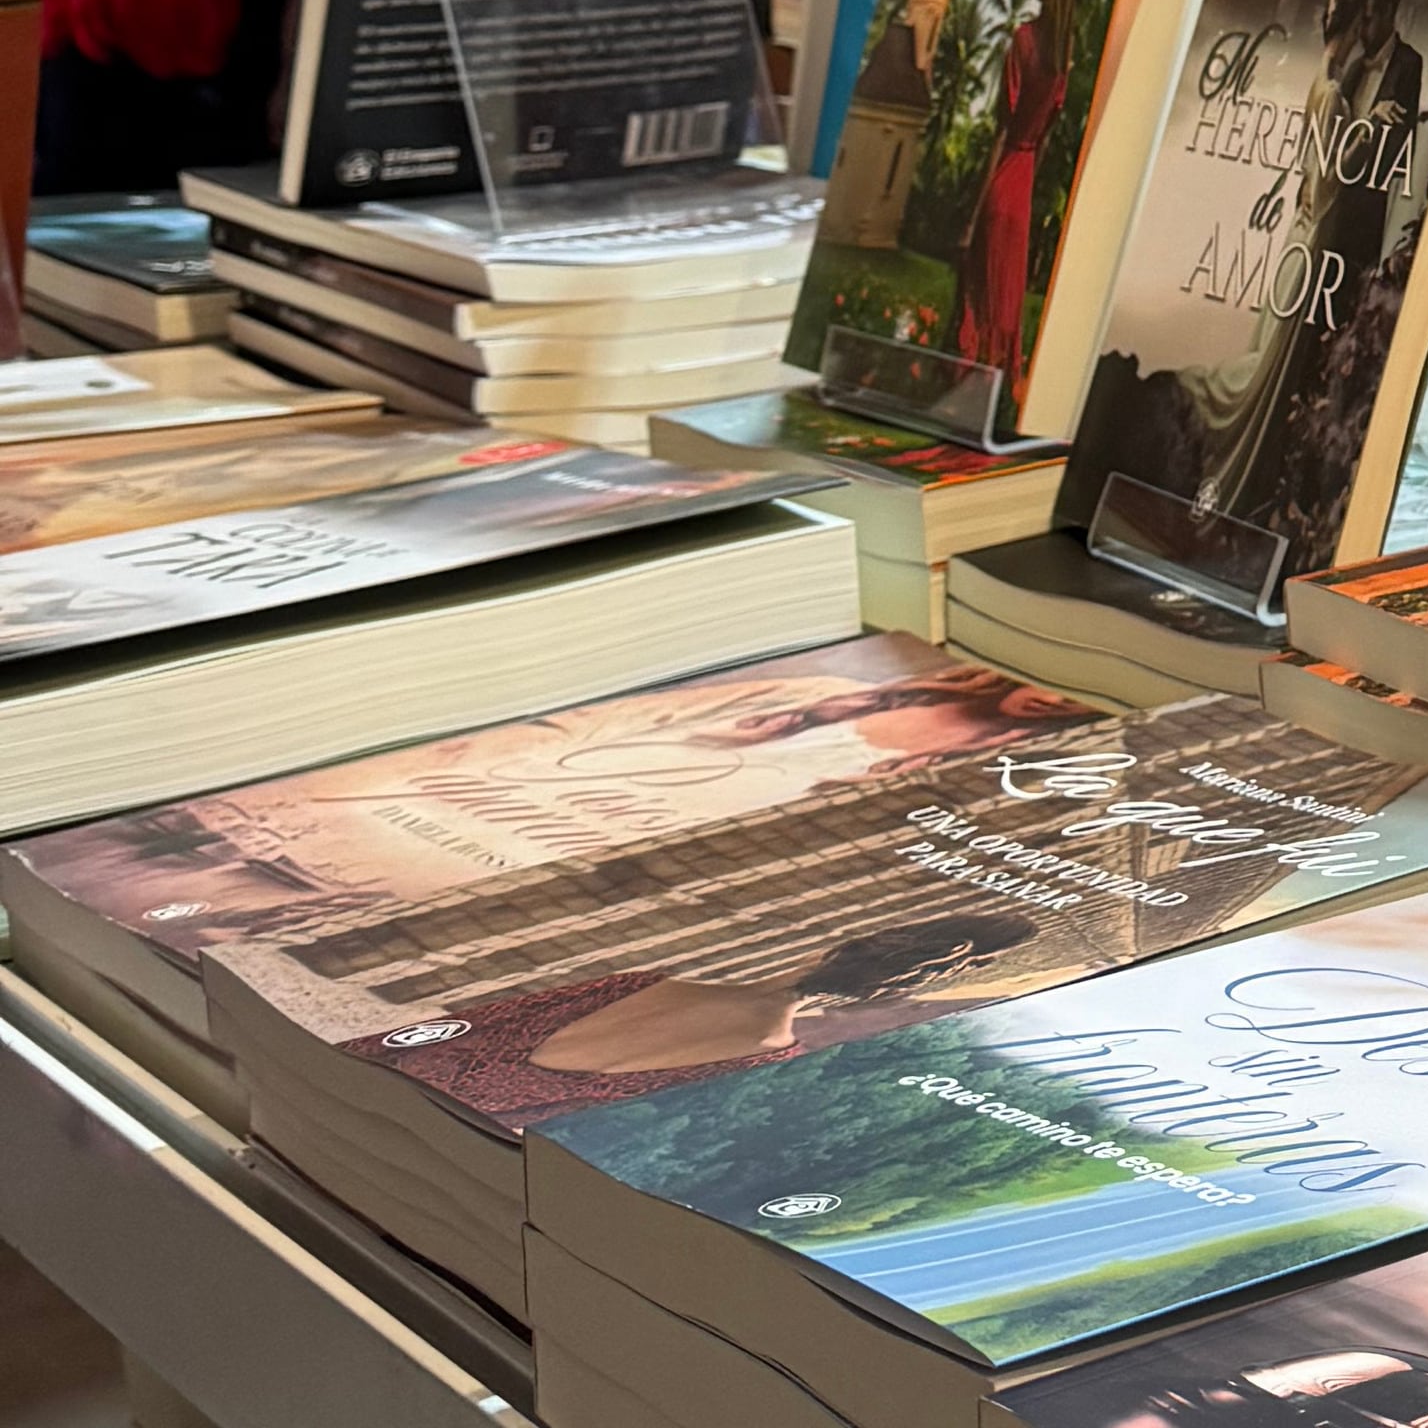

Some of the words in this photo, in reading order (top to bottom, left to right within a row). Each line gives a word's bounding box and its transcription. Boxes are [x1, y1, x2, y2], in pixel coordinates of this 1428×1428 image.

[1185, 89, 1414, 198] HERENCIA
[1248, 170, 1287, 235] de
[1181, 222, 1346, 332] AMOR
[1180, 760, 1285, 808] Mariana
[1280, 794, 1385, 825] Santini
[895, 841, 983, 884] PARA
[972, 864, 1084, 913] SANAR
[904, 804, 973, 841] UNA
[968, 832, 1190, 910] OPORTUNIDAD
[1061, 800, 1265, 844] que
[1178, 830, 1407, 878] fui
[868, 1028, 1427, 1193] fronteras
[1208, 1048, 1341, 1087] sin
[897, 1071, 996, 1108] ¿Qué
[974, 1099, 1092, 1149] camino
[1083, 1139, 1128, 1161] te
[1116, 1154, 1258, 1208] espera?
